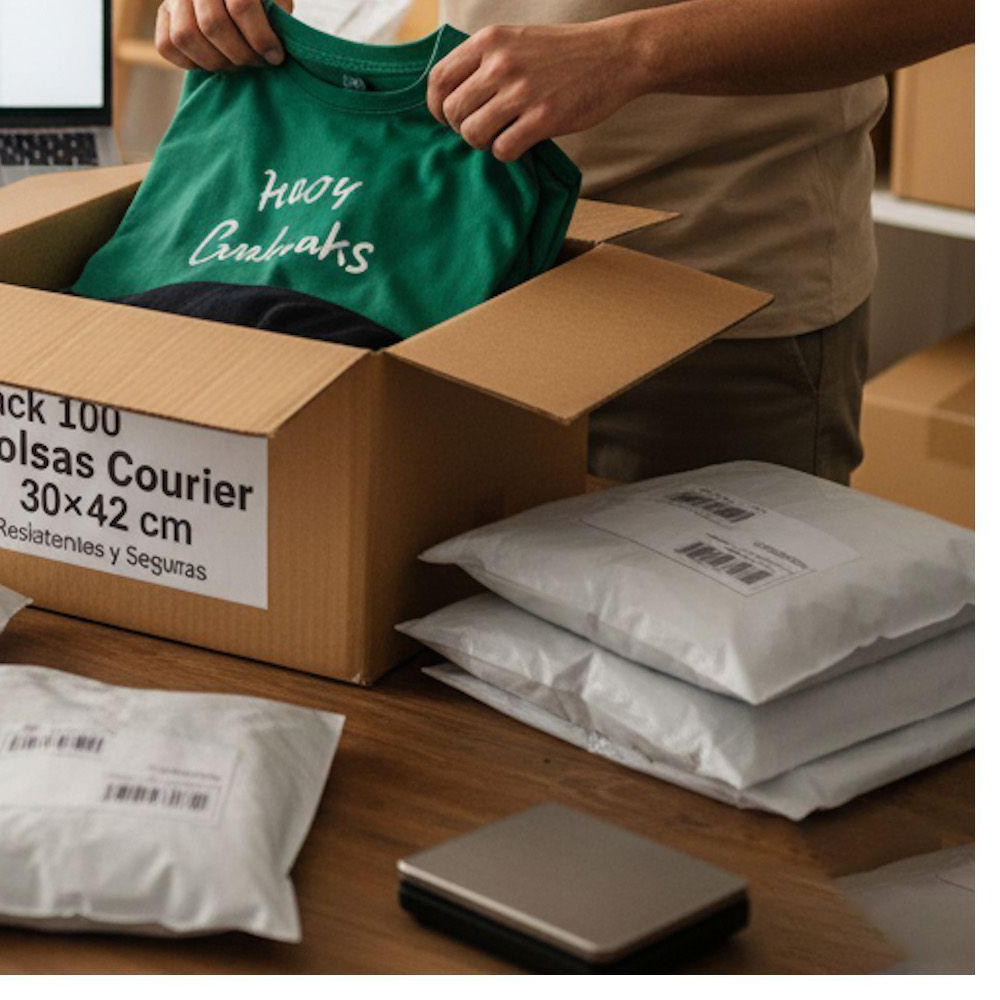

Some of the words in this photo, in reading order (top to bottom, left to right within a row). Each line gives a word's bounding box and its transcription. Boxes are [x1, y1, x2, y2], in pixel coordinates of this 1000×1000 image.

[58, 397, 121, 437] 100
[107, 450, 253, 511] Courier
[140, 510, 193, 545] cm
[109, 547, 121, 566] y
